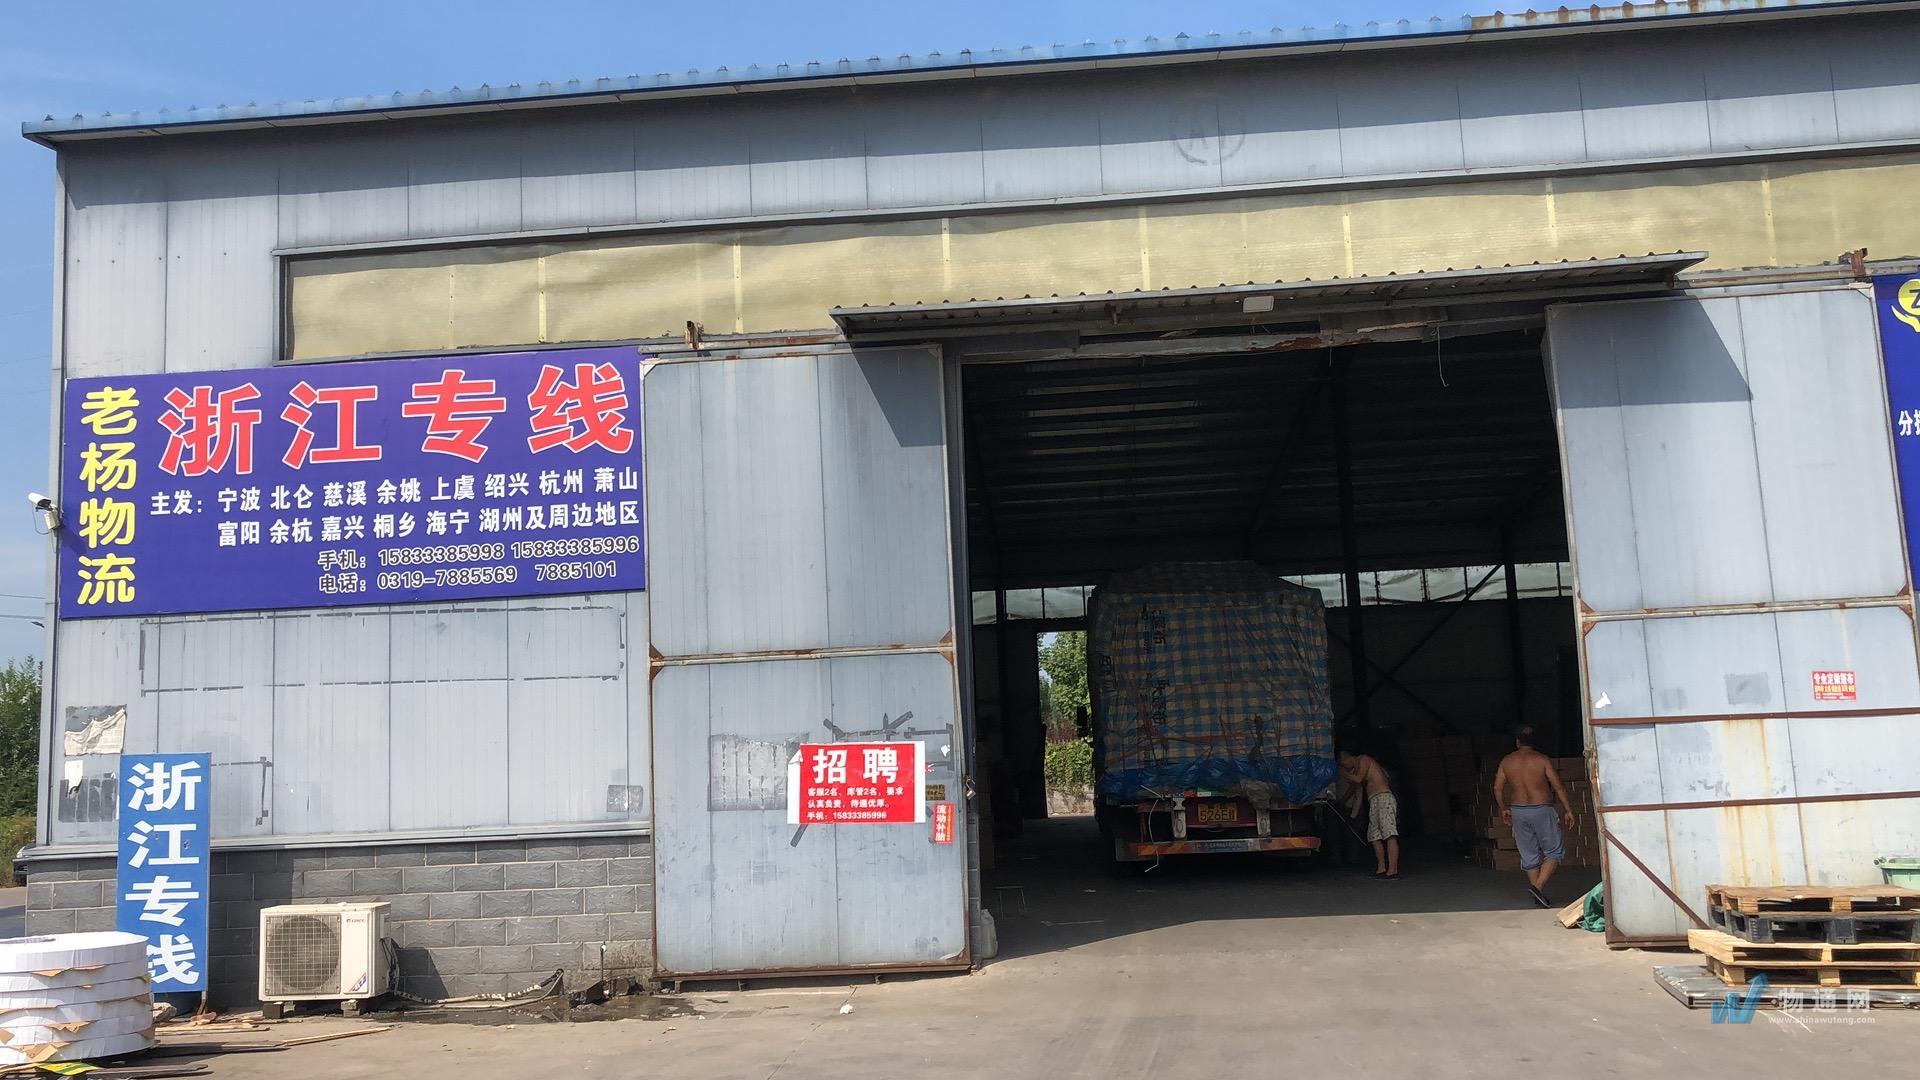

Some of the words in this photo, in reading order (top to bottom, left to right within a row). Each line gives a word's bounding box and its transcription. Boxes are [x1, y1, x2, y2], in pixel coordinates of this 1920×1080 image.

[157, 362, 635, 477] 浙江专线
[76, 385, 140, 605] 老杨物流
[150, 489, 202, 516] 主发：
[217, 486, 261, 513] 宁波
[270, 483, 314, 510] 北仑
[322, 480, 367, 507] 慈溪
[376, 477, 421, 504] 余姚
[430, 474, 475, 501] 上虞
[484, 472, 529, 499] 绍兴
[538, 469, 583, 495] 杭州
[593, 466, 638, 492] 萧山
[217, 520, 260, 546] 富阳
[269, 517, 313, 544] 余杭
[321, 515, 365, 542] 嘉兴
[373, 512, 416, 539] 桐乡
[426, 509, 470, 536] 海宁
[478, 500, 639, 534] 湖州及周边地区
[317, 549, 366, 571] 手机：
[378, 543, 505, 566] 15833385998
[511, 536, 639, 559] 15833385996
[319, 573, 366, 594] 电话：
[377, 566, 518, 590] 0319-7885569
[534, 560, 617, 582] 7885101
[812, 747, 899, 784] 招聘
[833, 811, 887, 820] 15833385996
[124, 760, 201, 986] 浙江专线
